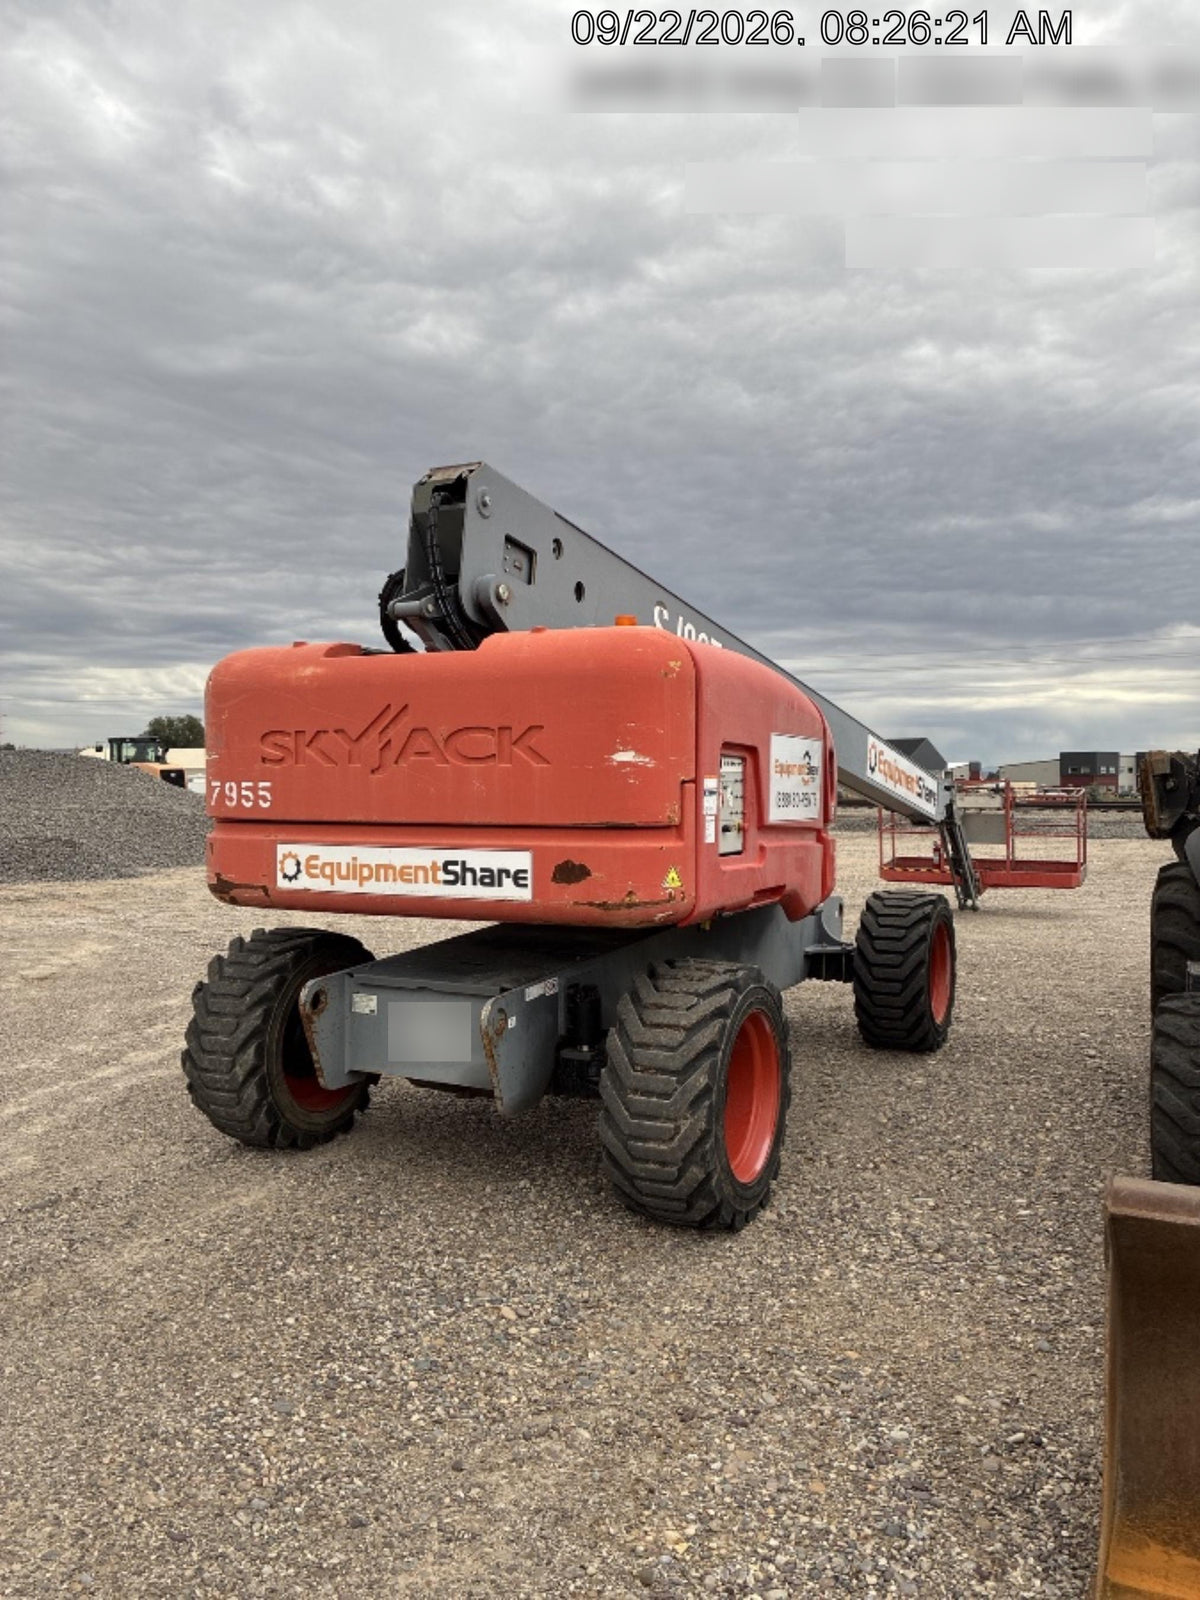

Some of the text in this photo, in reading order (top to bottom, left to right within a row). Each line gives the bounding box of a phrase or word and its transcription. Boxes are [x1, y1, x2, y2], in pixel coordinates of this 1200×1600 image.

[260, 703, 551, 778] SKYJACK
[210, 781, 272, 808] 7955
[304, 855, 529, 888] EquipmentShare
